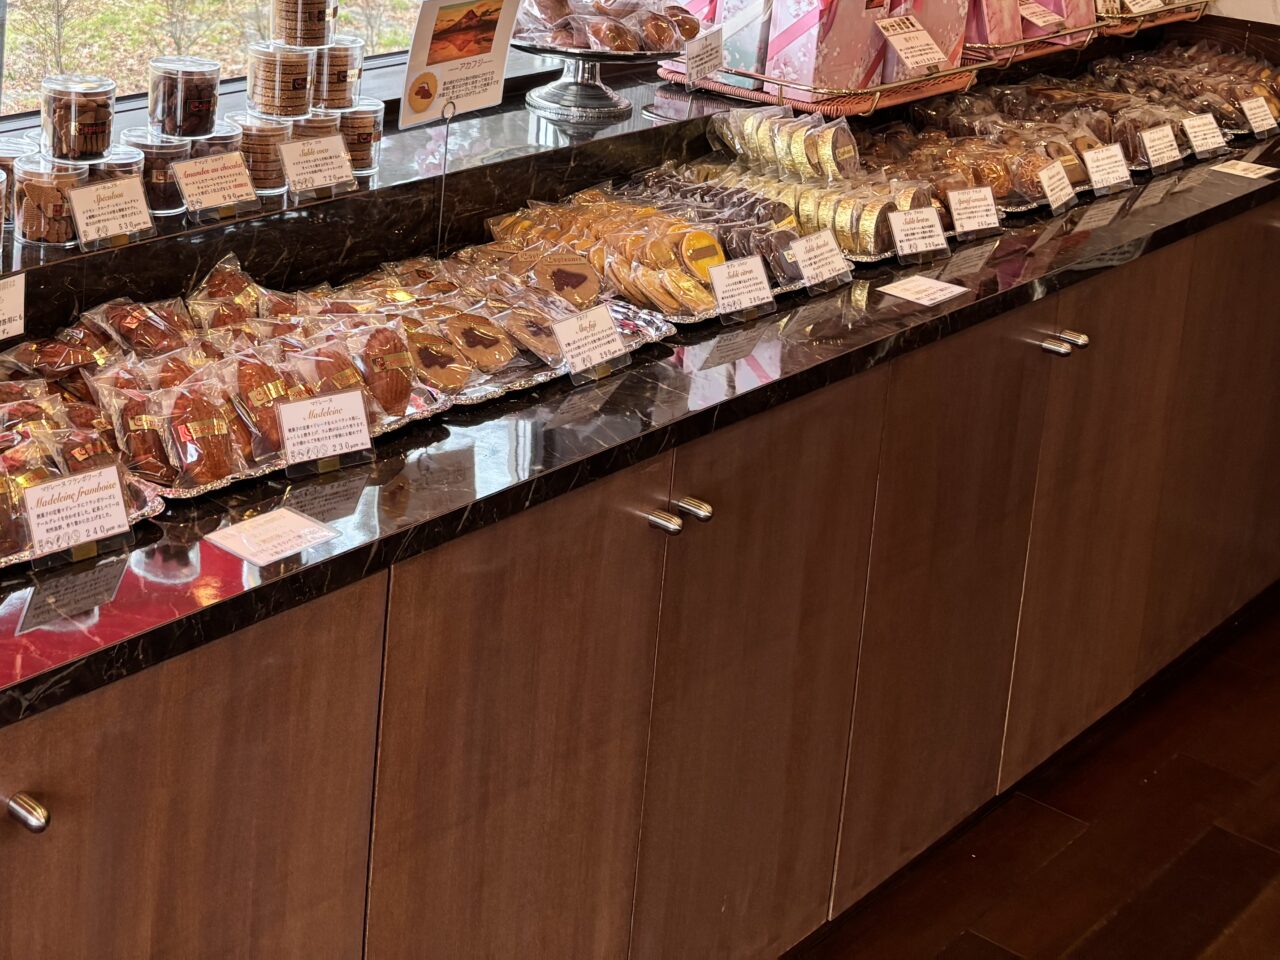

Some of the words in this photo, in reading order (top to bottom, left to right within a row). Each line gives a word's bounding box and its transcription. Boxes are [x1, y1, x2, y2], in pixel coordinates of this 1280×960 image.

[459, 58, 484, 71] アカフジ
[303, 406, 344, 420] Madeleine
[32, 491, 77, 509] Madeleine
[73, 481, 117, 503] framboise
